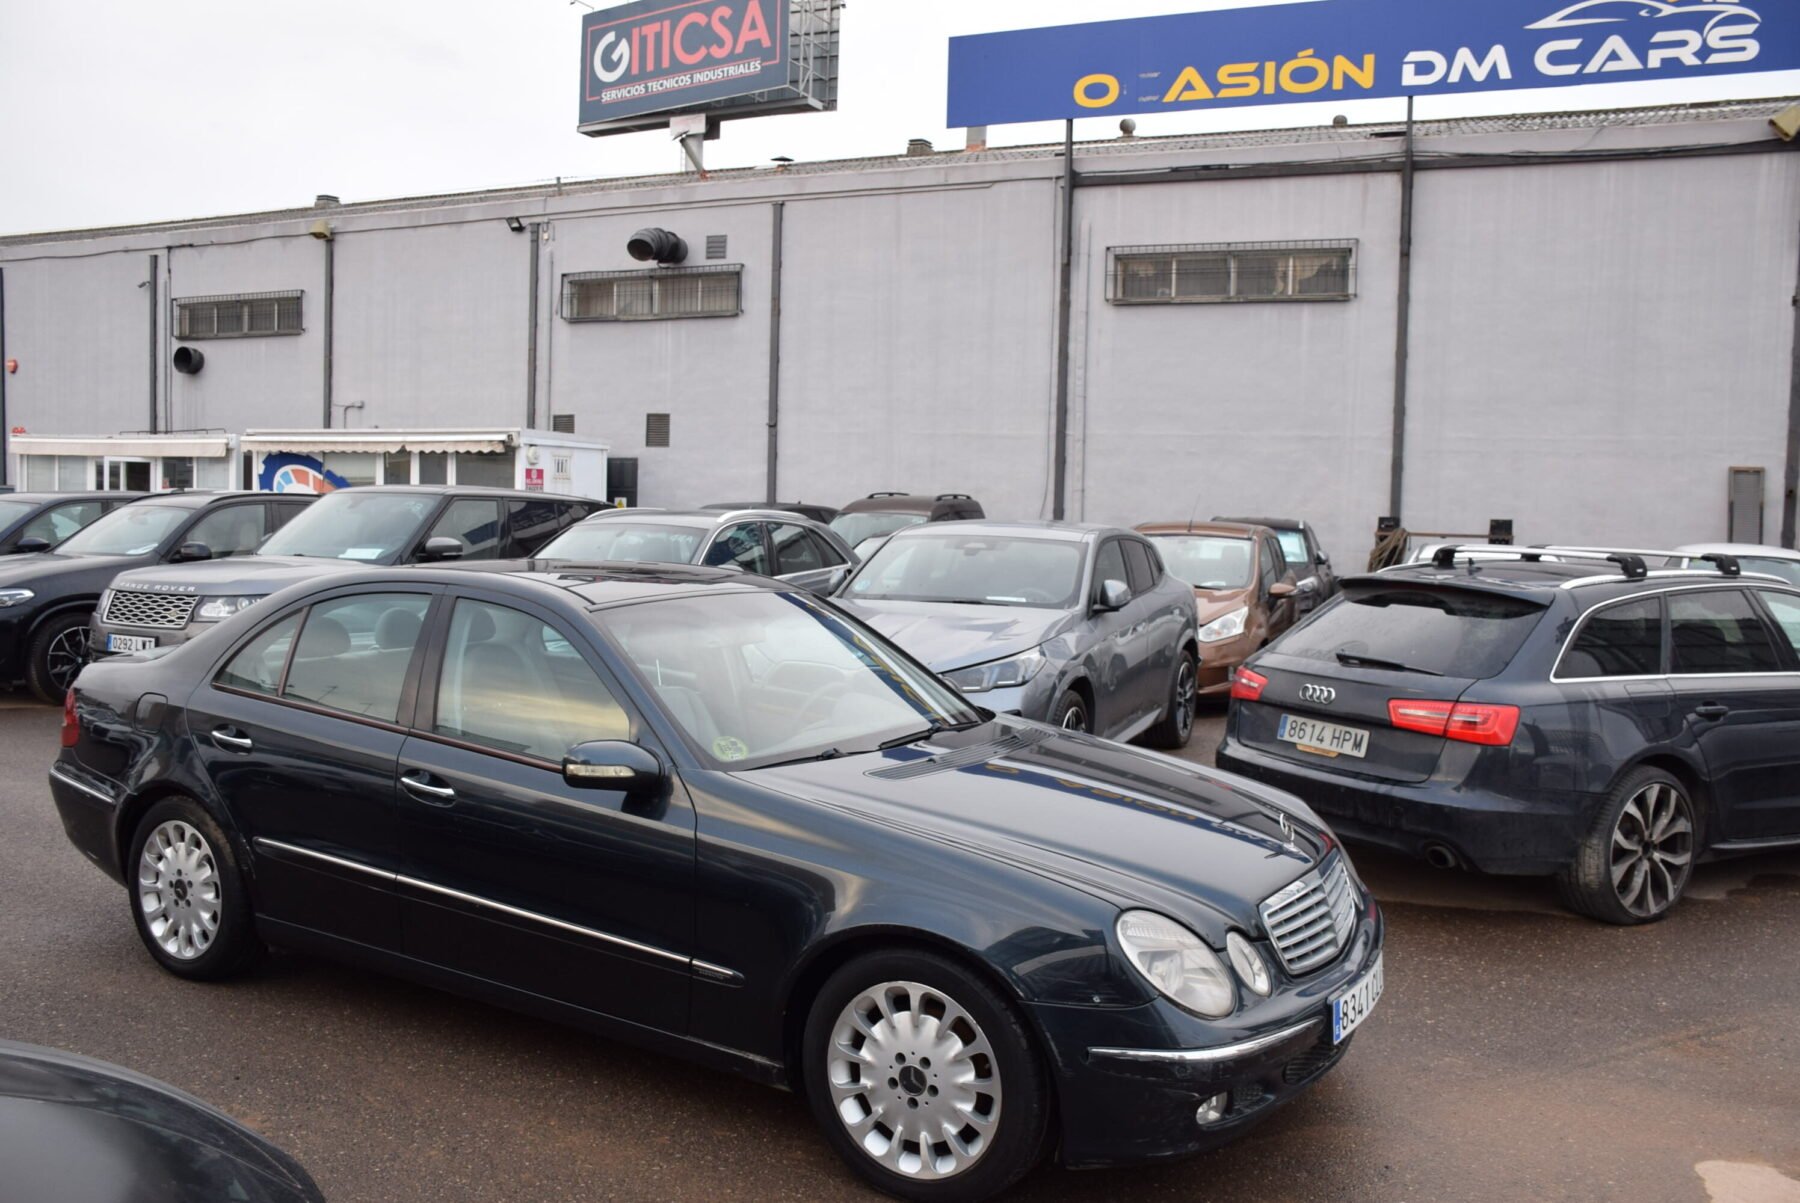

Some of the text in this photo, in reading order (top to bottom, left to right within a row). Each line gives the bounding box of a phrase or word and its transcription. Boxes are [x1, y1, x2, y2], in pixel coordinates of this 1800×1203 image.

[594, 0, 771, 82] GITICSA
[1402, 44, 1512, 86] DM
[1533, 23, 1760, 76] CARS
[601, 60, 761, 102] SERVICIOS TECNICOS INDUSTRIALES
[154, 584, 196, 592] ROVER
[112, 636, 133, 651] 0292
[1288, 720, 1365, 753] 8614 HPM
[1342, 982, 1369, 1030] 8341
